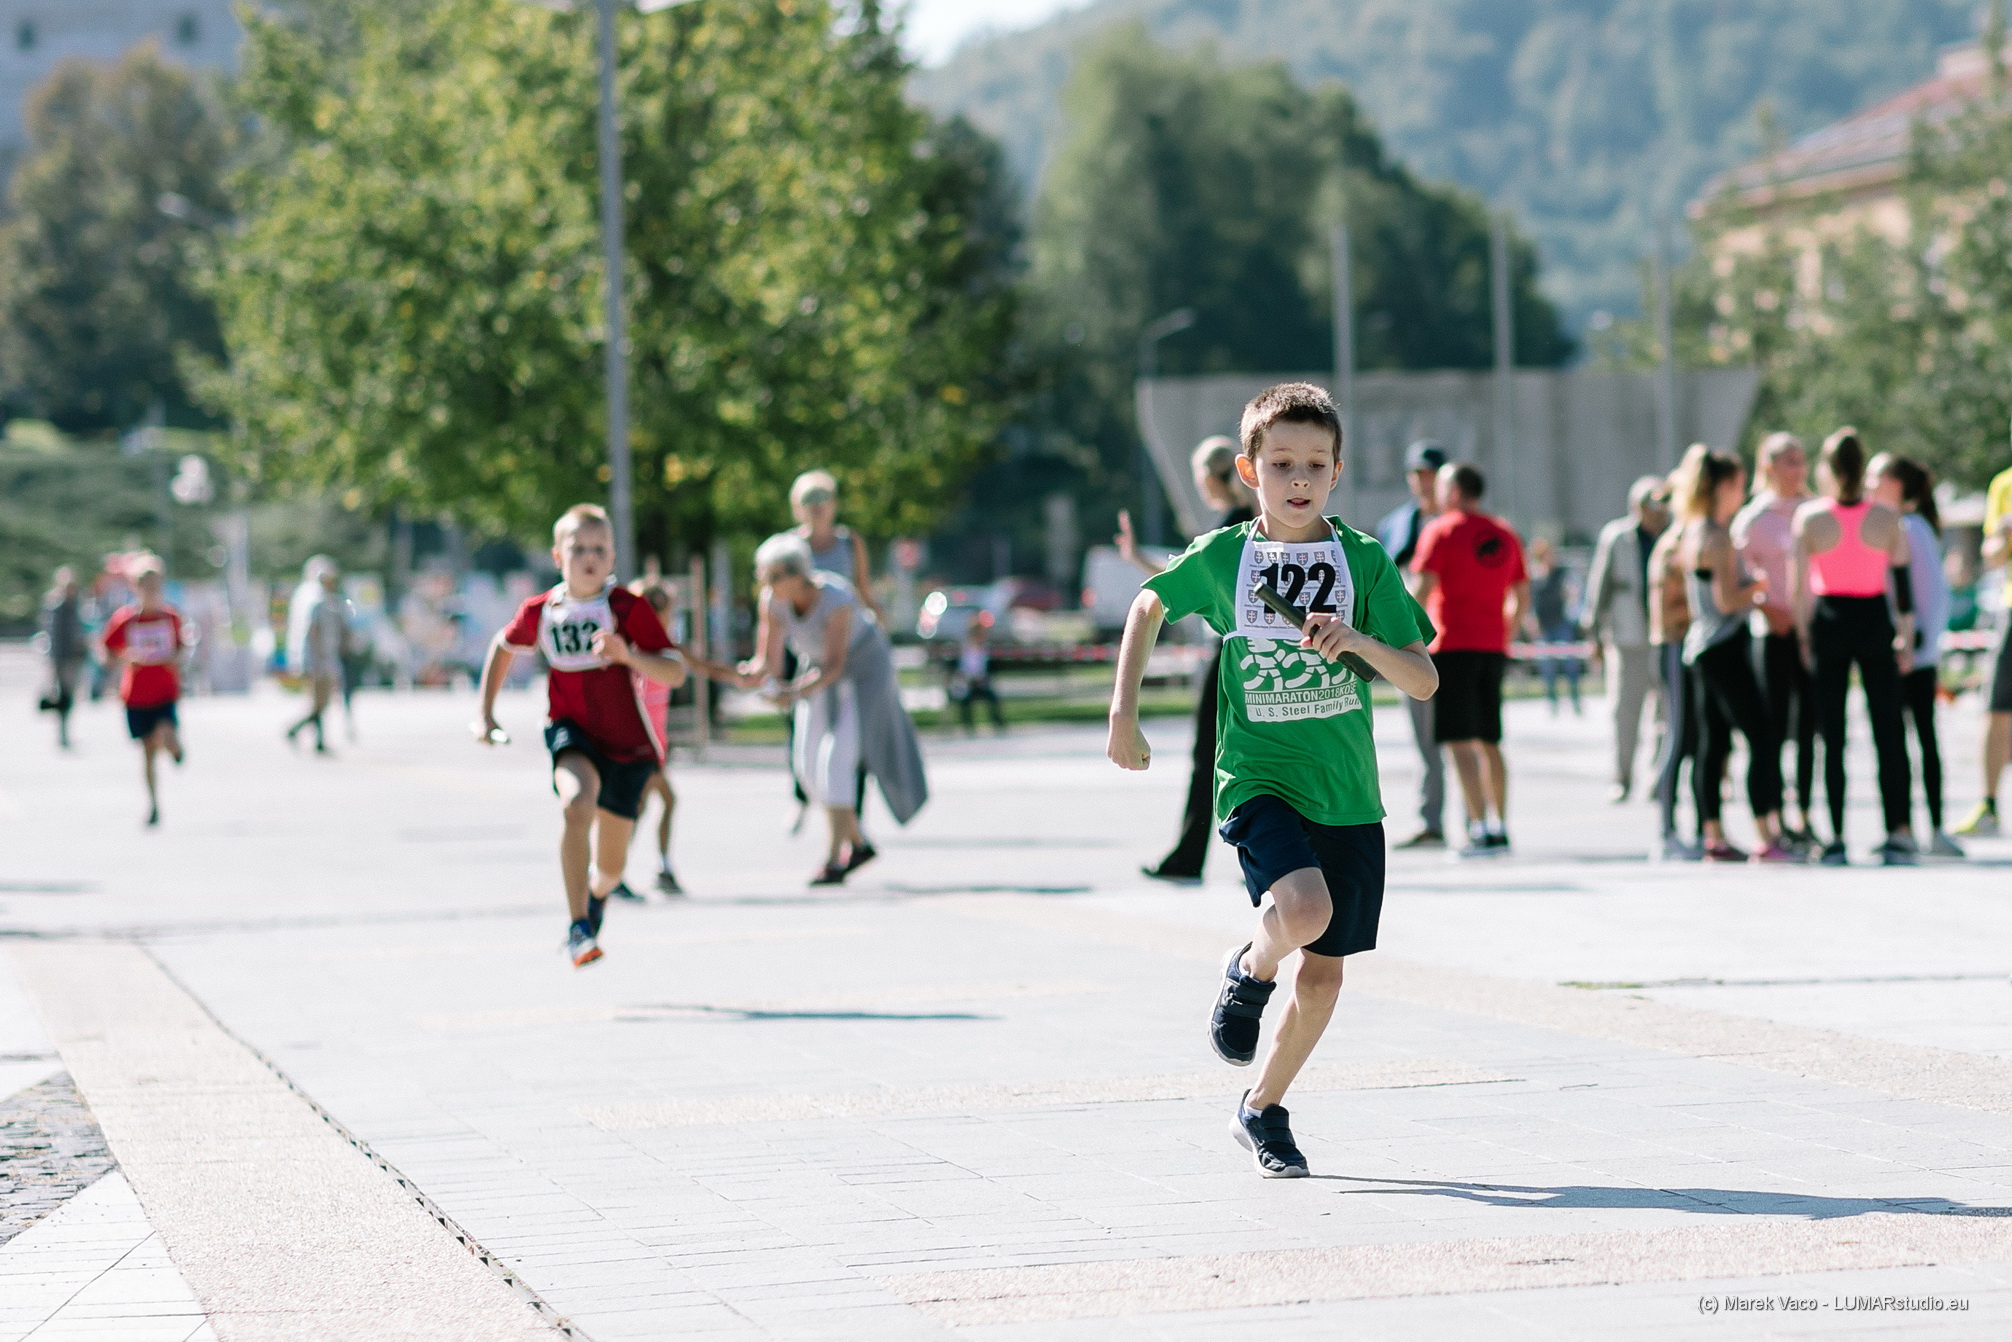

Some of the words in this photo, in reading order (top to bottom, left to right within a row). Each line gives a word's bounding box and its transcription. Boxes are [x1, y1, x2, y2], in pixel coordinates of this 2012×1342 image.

[1260, 562, 1337, 614] 122
[551, 621, 600, 654] 132
[1255, 707, 1265, 718] U.
[1268, 706, 1279, 718] S.
[1282, 704, 1310, 717] Steel
[1314, 699, 1344, 715] Family
